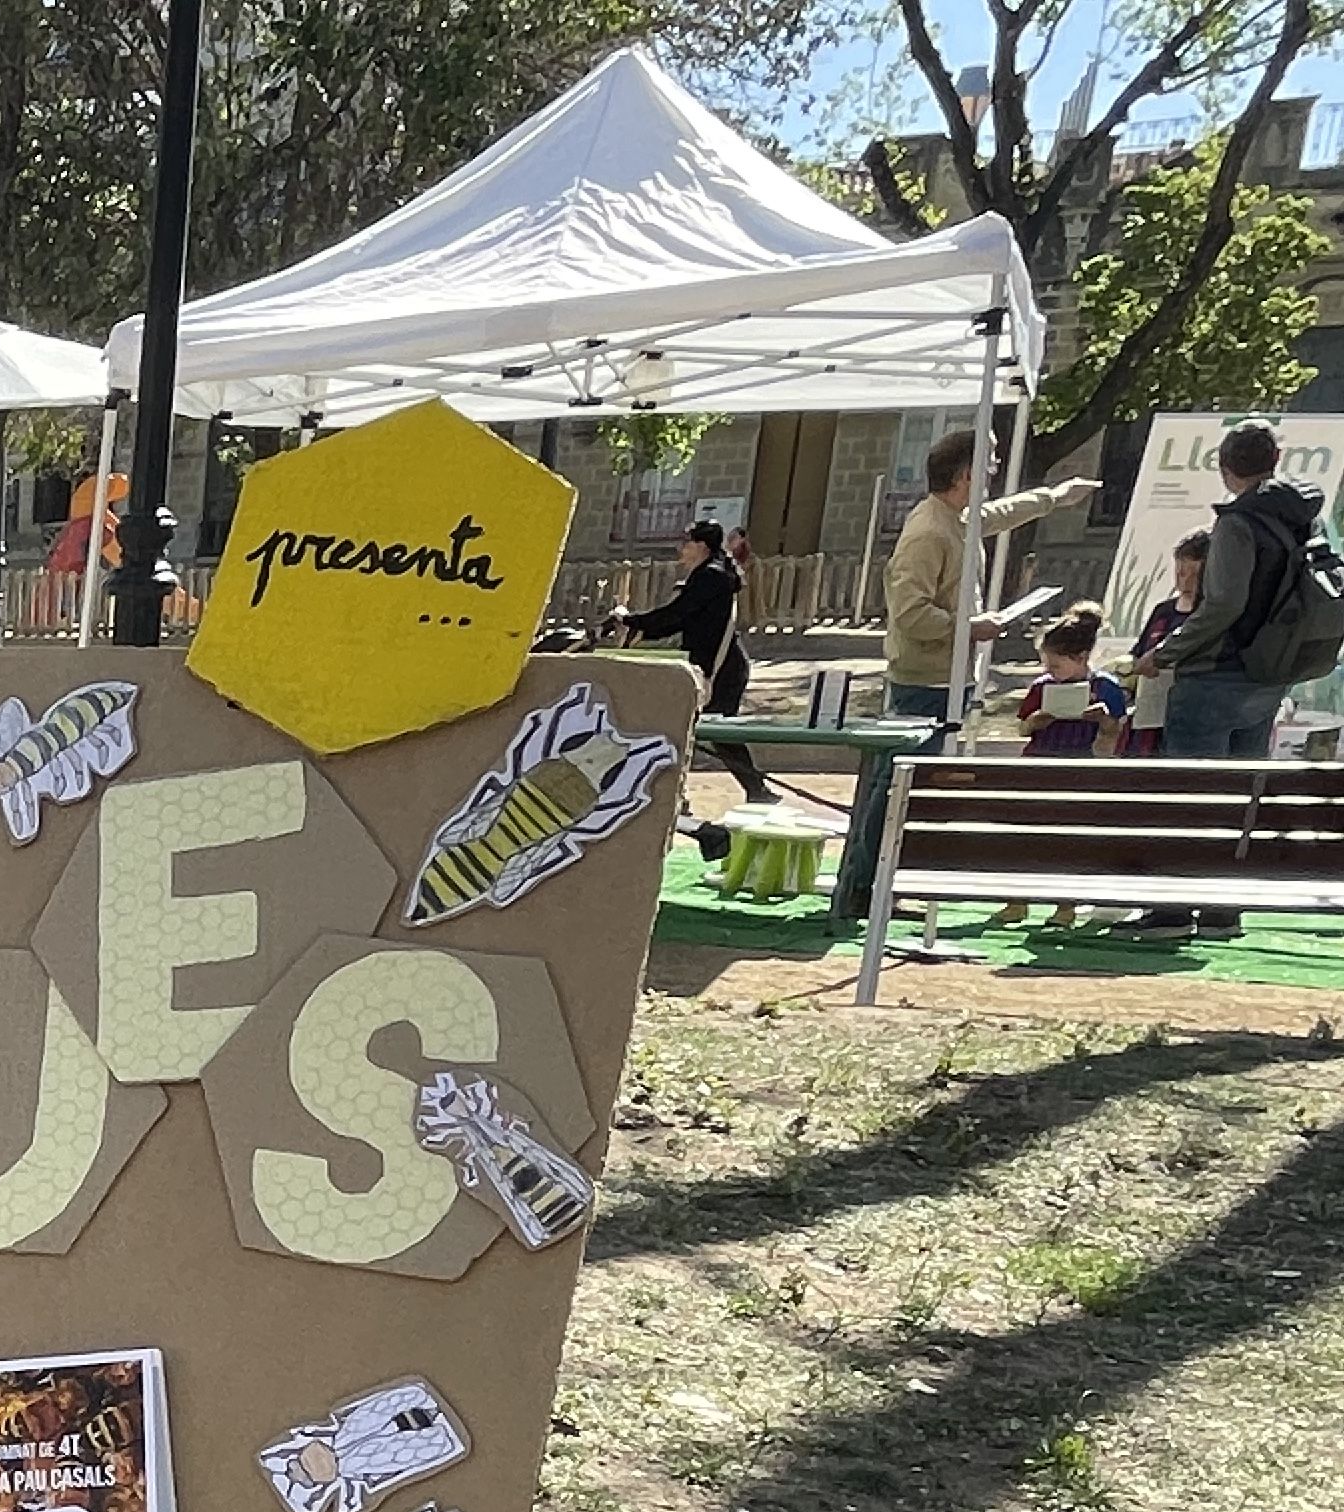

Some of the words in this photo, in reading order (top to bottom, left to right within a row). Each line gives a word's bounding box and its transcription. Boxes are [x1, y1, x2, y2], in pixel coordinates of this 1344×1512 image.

[1158, 436, 1333, 475] Llem
[246, 515, 505, 608] presenta
[14, 1469, 47, 1492] PAU
[51, 1465, 116, 1491] CASALS
